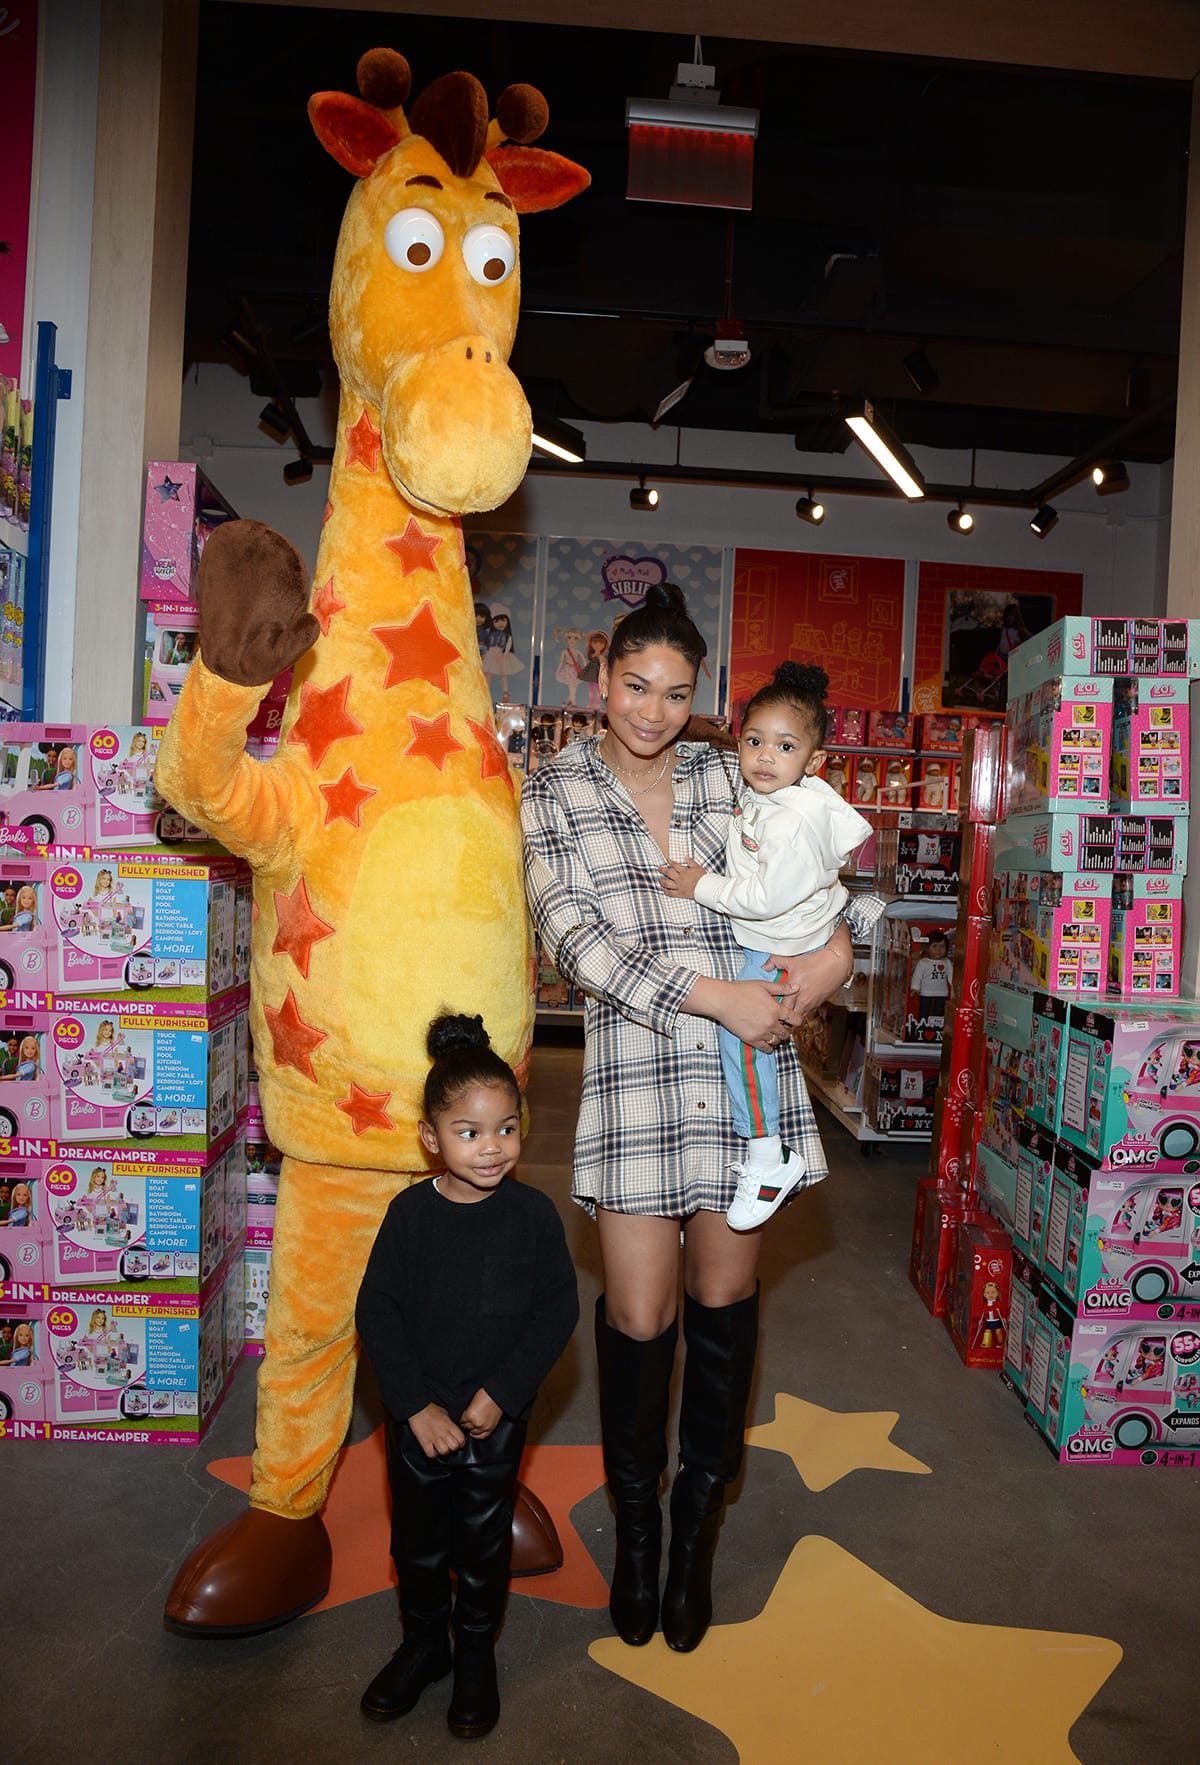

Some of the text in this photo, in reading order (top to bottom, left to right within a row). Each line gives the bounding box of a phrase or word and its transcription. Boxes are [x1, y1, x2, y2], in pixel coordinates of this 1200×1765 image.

[155, 604, 178, 612] 3-IN-1
[1078, 682, 1100, 692] LOL
[1153, 684, 1176, 694] LOL
[93, 736, 115, 748] 60
[66, 810, 76, 824] B
[104, 809, 128, 823] Barbie
[0, 828, 29, 842] Barbie
[122, 866, 205, 877] FULLY FURNISHED
[54, 873, 78, 886] 60
[1078, 878, 1100, 888] LOL
[1149, 878, 1169, 888] LOL
[919, 883, 951, 892] I NY
[154, 944, 194, 953] & MORE!
[27, 953, 38, 968] B
[68, 952, 94, 967] Barbie
[56, 1000, 154, 1014] DREAMCAMPER
[56, 1023, 80, 1037] 60
[154, 1019, 205, 1028] FURNISHED
[918, 1030, 943, 1040] I N
[156, 1094, 195, 1102] & MORE!
[30, 1102, 41, 1117] B
[70, 1101, 96, 1116] Barbie
[914, 1120, 932, 1128] NY
[1128, 1132, 1152, 1140] LOL
[0, 1139, 156, 1162] 3-IN-1 DREAMCAMPER
[147, 1166, 198, 1174] FURNISHED
[49, 1170, 73, 1184] 60
[149, 1238, 188, 1247] & MORE!
[23, 1247, 33, 1262] B
[64, 1246, 89, 1260] Barbie
[52, 1292, 149, 1305] DREAMCAMPER
[116, 1306, 196, 1316] FULLY FURNISHED
[1176, 1306, 1200, 1319] 4-IN
[50, 1312, 73, 1325] 60
[157, 1378, 187, 1386] MORE!
[24, 1385, 35, 1400] B
[64, 1385, 90, 1399] Barbie
[54, 1430, 149, 1443] DREAMCAMPER
[1160, 1452, 1196, 1465] 4-IN-1
